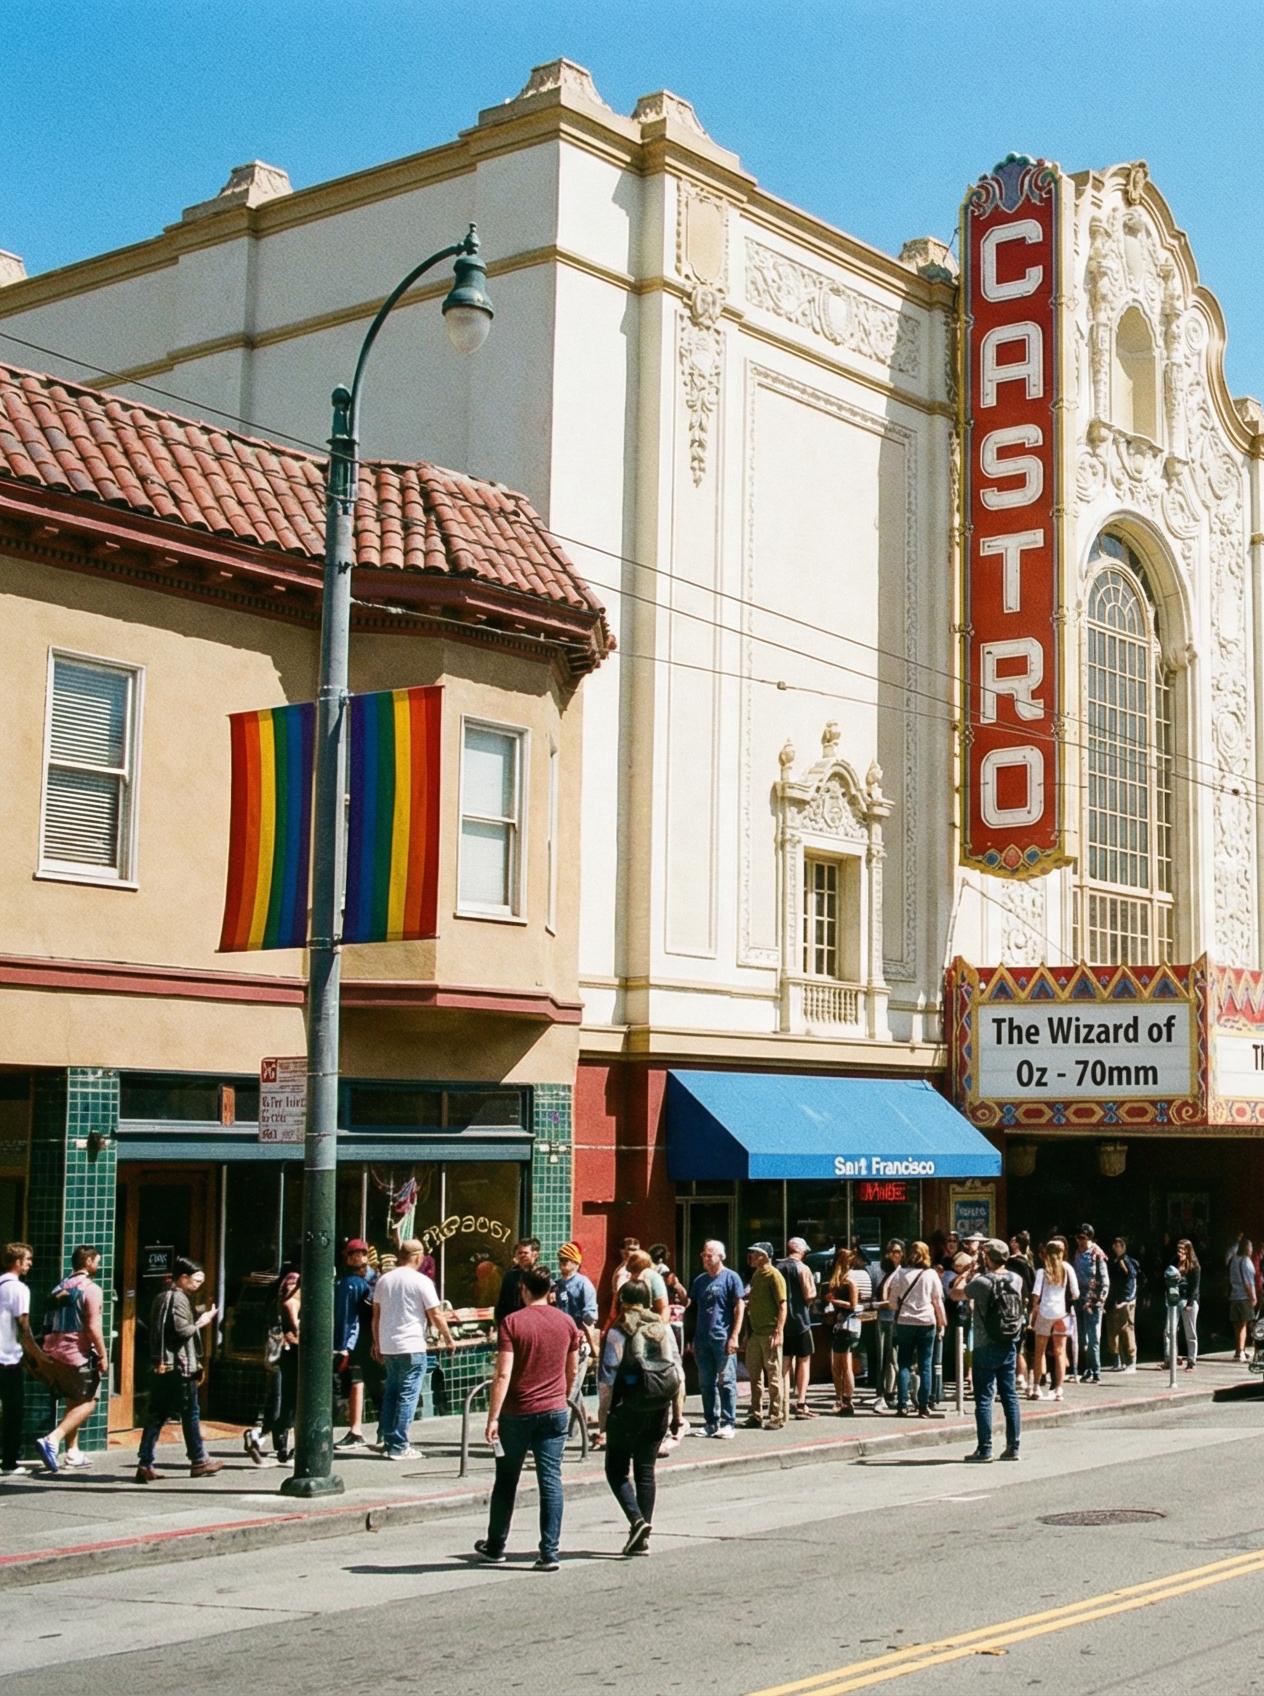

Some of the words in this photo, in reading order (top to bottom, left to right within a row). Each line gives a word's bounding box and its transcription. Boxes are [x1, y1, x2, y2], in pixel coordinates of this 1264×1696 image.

[979, 218, 1045, 830] CASTRO
[991, 1017, 1041, 1045] The
[1047, 1015, 1139, 1044] Wizard
[1147, 1014, 1177, 1043] of
[1016, 1059, 1048, 1087] Oz
[1074, 1059, 1158, 1087] 70mm
[871, 1156, 935, 1175] Francisco
